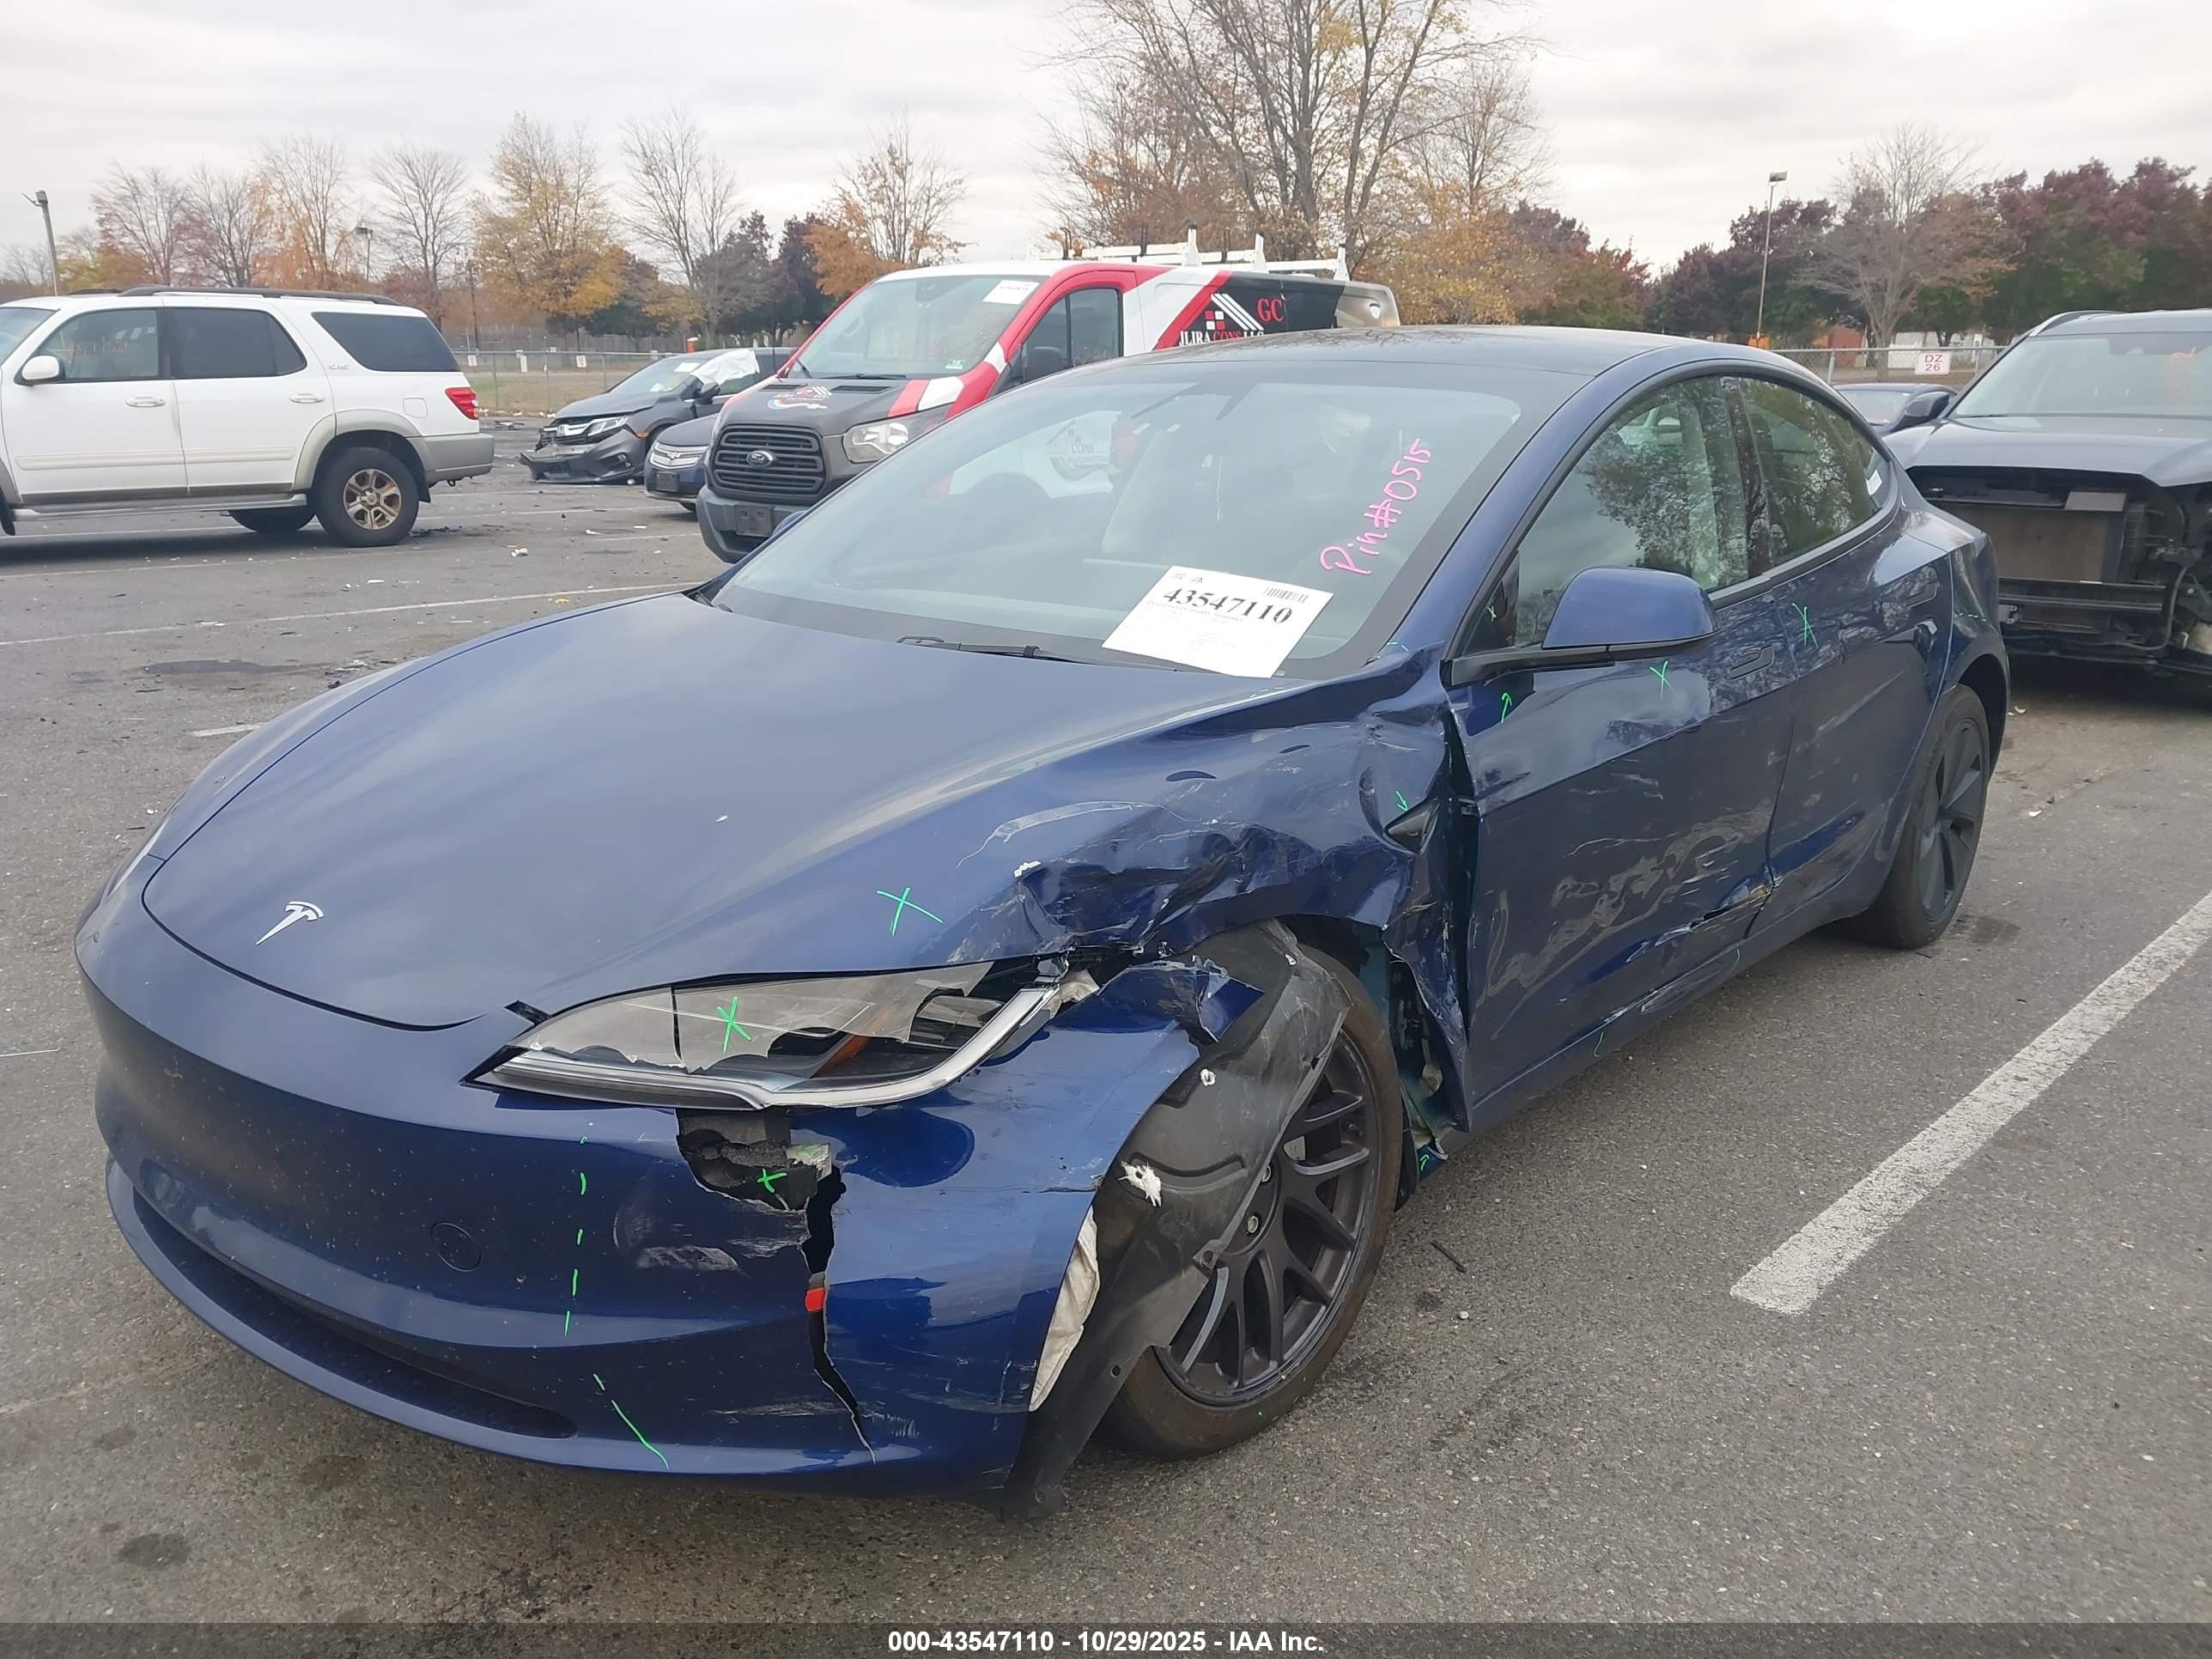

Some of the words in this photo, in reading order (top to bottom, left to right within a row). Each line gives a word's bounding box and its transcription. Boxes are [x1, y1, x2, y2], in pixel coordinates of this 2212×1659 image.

[1257, 298, 1285, 321] GC
[1924, 354, 1943, 363] DZ
[1924, 363, 1942, 372] 26
[1163, 587, 1293, 624] 43547110
